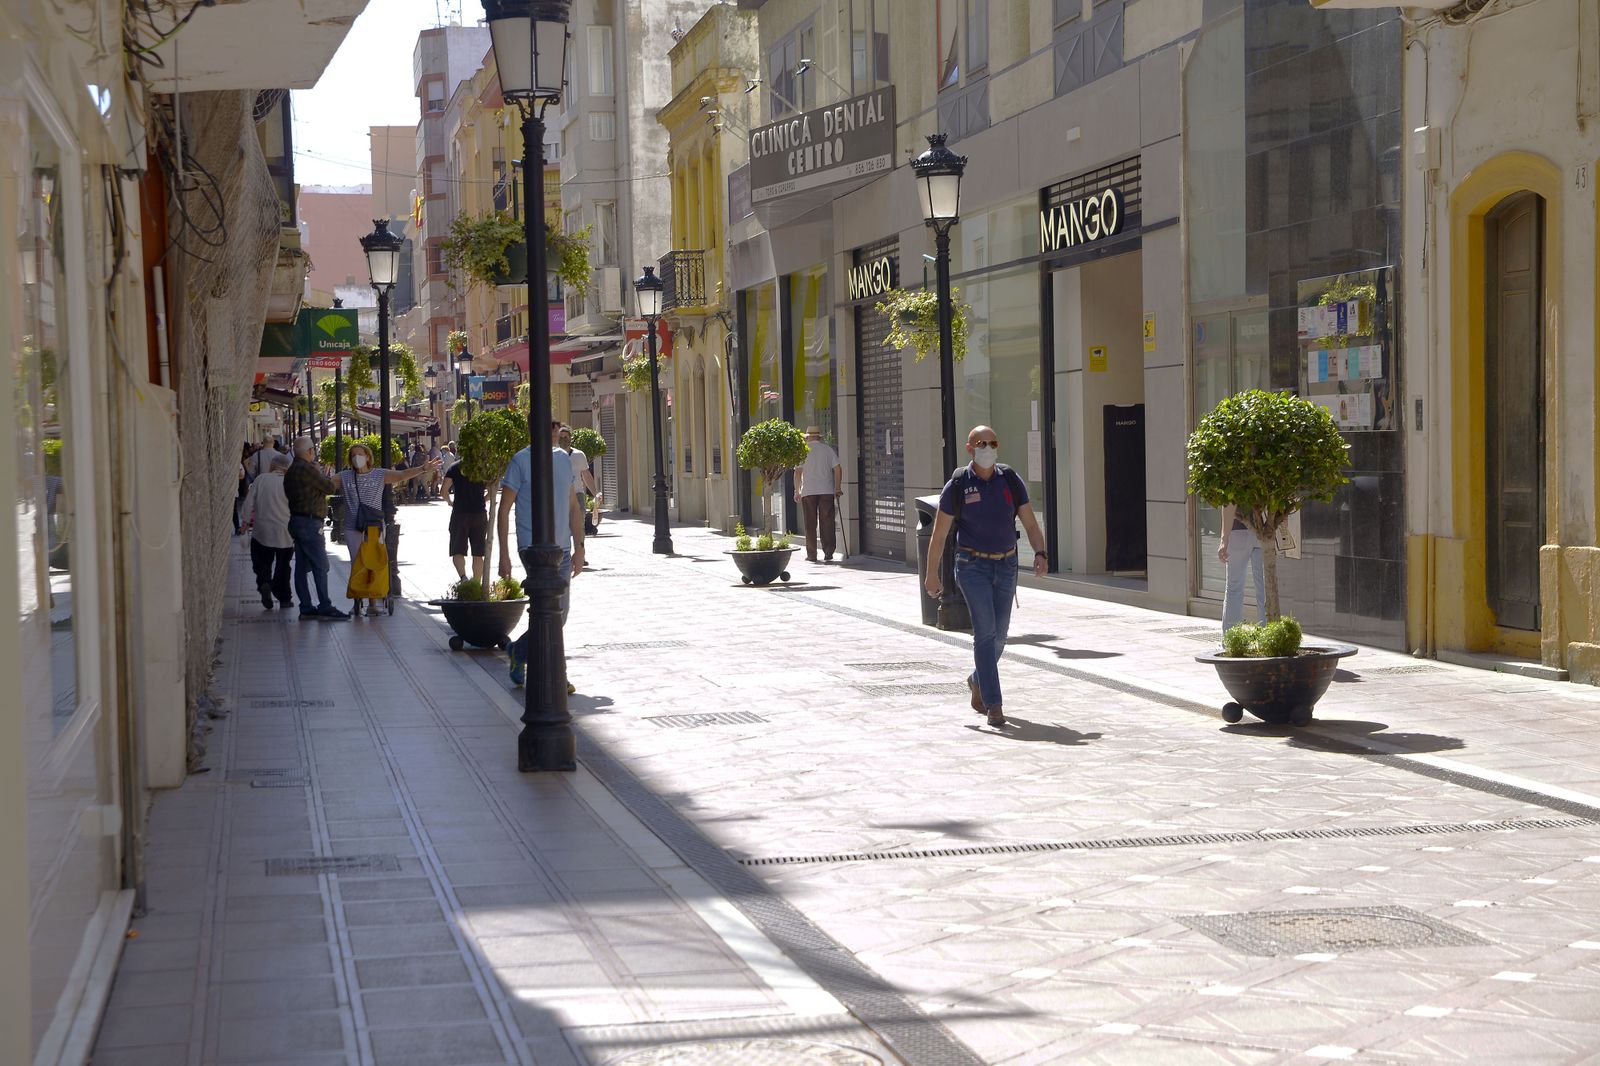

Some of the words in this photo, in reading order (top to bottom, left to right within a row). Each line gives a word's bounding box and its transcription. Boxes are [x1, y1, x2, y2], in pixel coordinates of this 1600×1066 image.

[752, 116, 812, 158] CLINICA
[823, 94, 885, 138] DENTAL
[788, 138, 844, 175] CENTRO
[1575, 167, 1586, 190] 43
[1040, 188, 1118, 253] MANGO
[848, 256, 891, 301] MANGO
[319, 339, 351, 350] Unicaja
